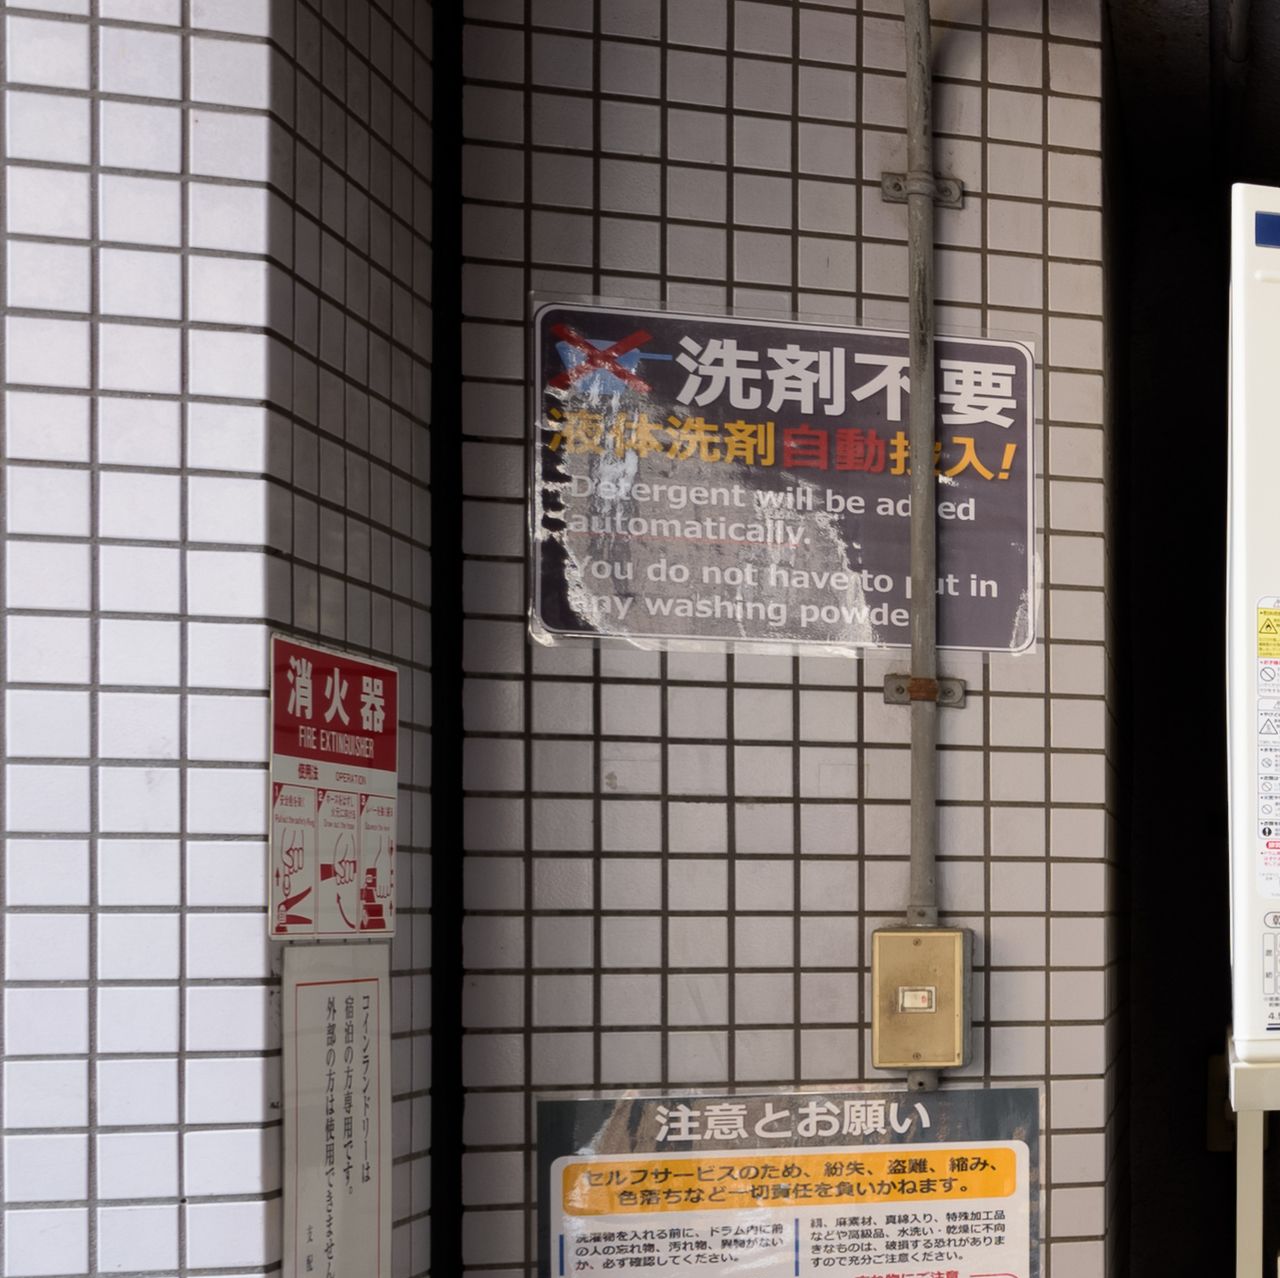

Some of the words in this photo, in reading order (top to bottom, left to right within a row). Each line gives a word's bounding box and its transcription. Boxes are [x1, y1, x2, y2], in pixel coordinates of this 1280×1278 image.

[675, 334, 1017, 429] 洗剤不要
[570, 475, 745, 509] Detergent
[758, 486, 812, 510] will
[826, 488, 865, 513] be
[876, 495, 975, 521] aded
[567, 514, 811, 545] automatically.
[647, 558, 689, 583] do
[702, 563, 757, 586] not
[771, 557, 850, 592] have
[860, 570, 893, 593] to
[970, 574, 998, 597] in
[645, 595, 787, 626] washing
[287, 655, 385, 733] 消火器
[299, 725, 317, 750] FIRE
[320, 730, 374, 759] EXTINGUISHER
[344, 995, 355, 1195] 宿泊の方専用です。
[361, 995, 371, 1183] コインランドリーは
[655, 1100, 931, 1142] 注意とお願い
[587, 1156, 999, 1187] セルフサービスのため、紛失、盗難、縮み、
[618, 1176, 968, 1206] 色落ちなど一切責任を負いかねます。
[575, 1223, 784, 1244] 洗濯物を入れる前に、ドラム内に前
[575, 1237, 784, 1257] の人の忘れ物、汚れ物、異物がない
[575, 1252, 740, 1271] か、必ず確認してください。
